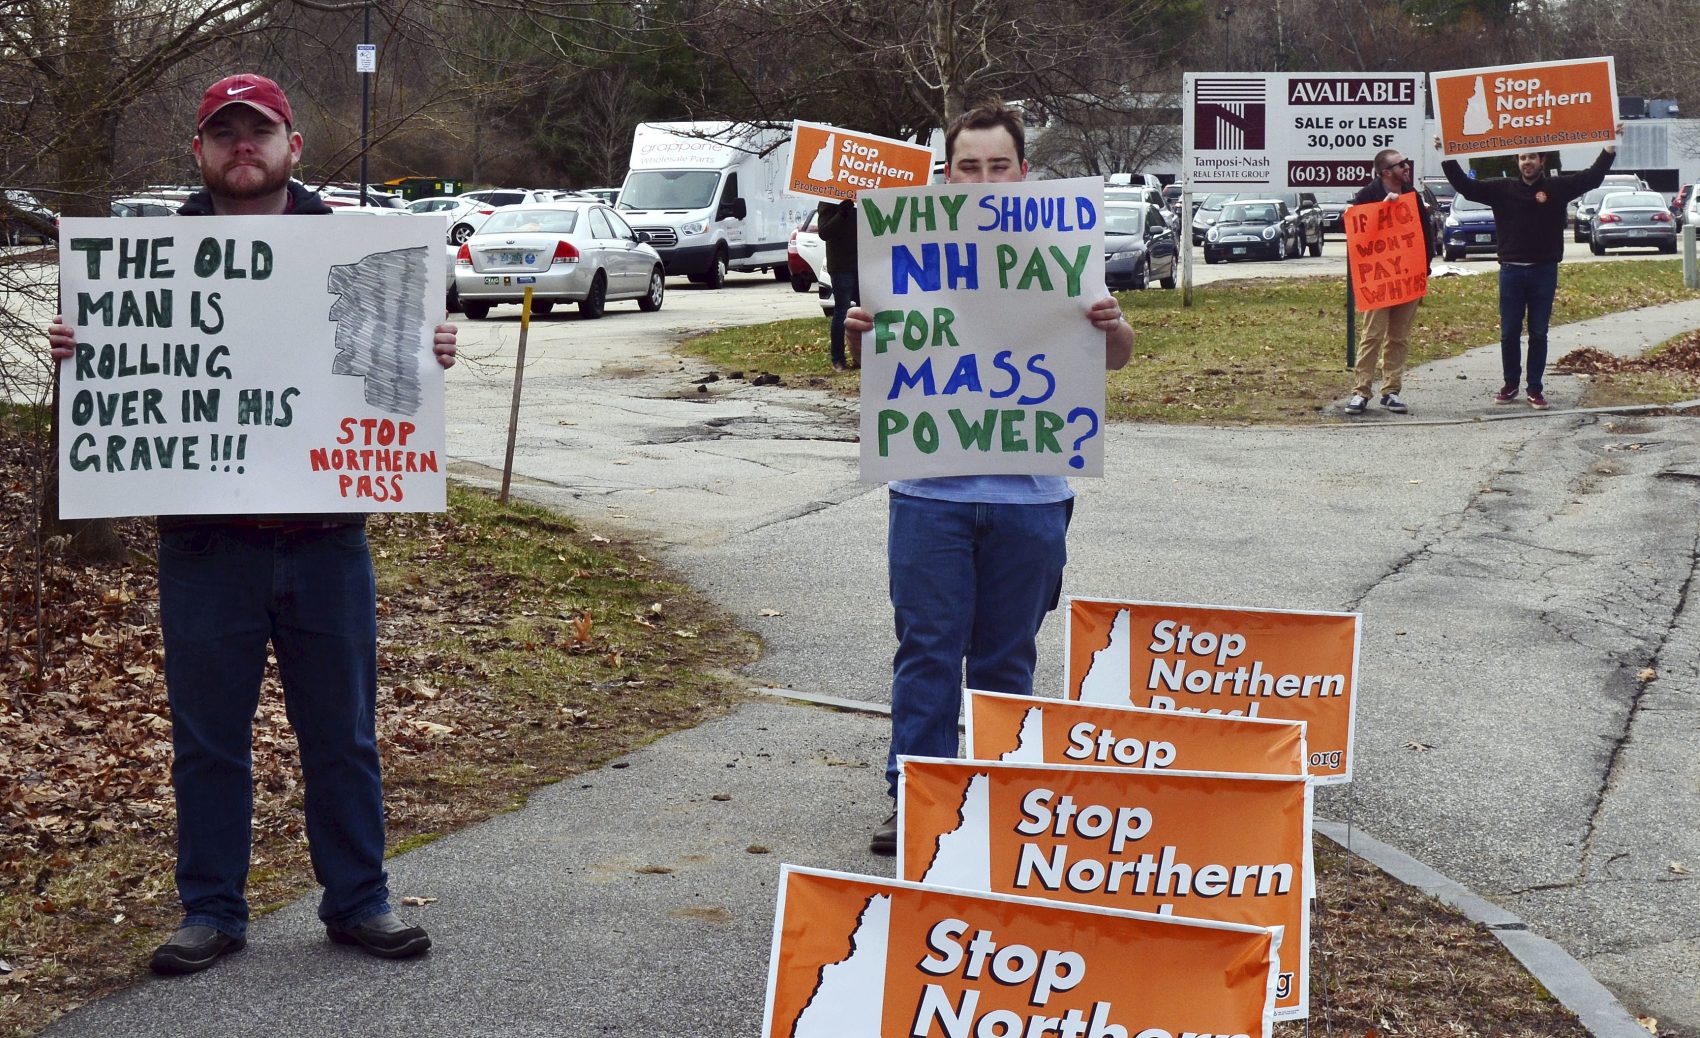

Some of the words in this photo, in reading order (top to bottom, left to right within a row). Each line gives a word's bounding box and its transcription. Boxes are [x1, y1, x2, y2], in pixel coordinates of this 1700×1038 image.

[1291, 82, 1411, 102] AVAILABLE
[1494, 77, 1540, 95] Stop
[1496, 90, 1592, 112] Northern
[1294, 117, 1334, 129] SALE
[1338, 119, 1354, 129] or
[1358, 117, 1407, 129] LEASE
[1498, 109, 1551, 130] Pass!
[841, 139, 879, 160] Stop
[1307, 135, 1367, 150] 30,000
[1372, 135, 1394, 147] SF
[837, 169, 882, 189] Pass!
[839, 154, 914, 181] Northern
[1194, 156, 1270, 169] Tamposi-Nash
[1290, 165, 1332, 183] (603)
[1336, 166, 1375, 181] 889-
[861, 194, 968, 237] WHY
[977, 194, 1097, 232] SHOULD
[70, 236, 175, 280] THE
[194, 236, 273, 280] OLD
[891, 242, 979, 295] NH
[996, 244, 1091, 298] PAY
[77, 289, 173, 329] MAN
[190, 291, 225, 335] IS
[873, 307, 960, 354] FOR
[75, 343, 232, 381] ROLLING
[887, 350, 1056, 406] MASS
[71, 388, 166, 426] OVER
[181, 388, 220, 423] IN
[238, 386, 301, 427] HIS
[335, 417, 416, 447] STOP
[877, 406, 1099, 469] POWER?
[69, 432, 248, 474] GRAVE!!!
[310, 448, 439, 473] NORTHERN
[338, 474, 404, 502] PASS
[1148, 618, 1247, 667] Stop
[1148, 658, 1345, 698] Northern
[1065, 721, 1177, 769] Stop
[1015, 787, 1154, 854] Stop
[1013, 842, 1293, 897] Northern
[917, 917, 1087, 1005] Stop
